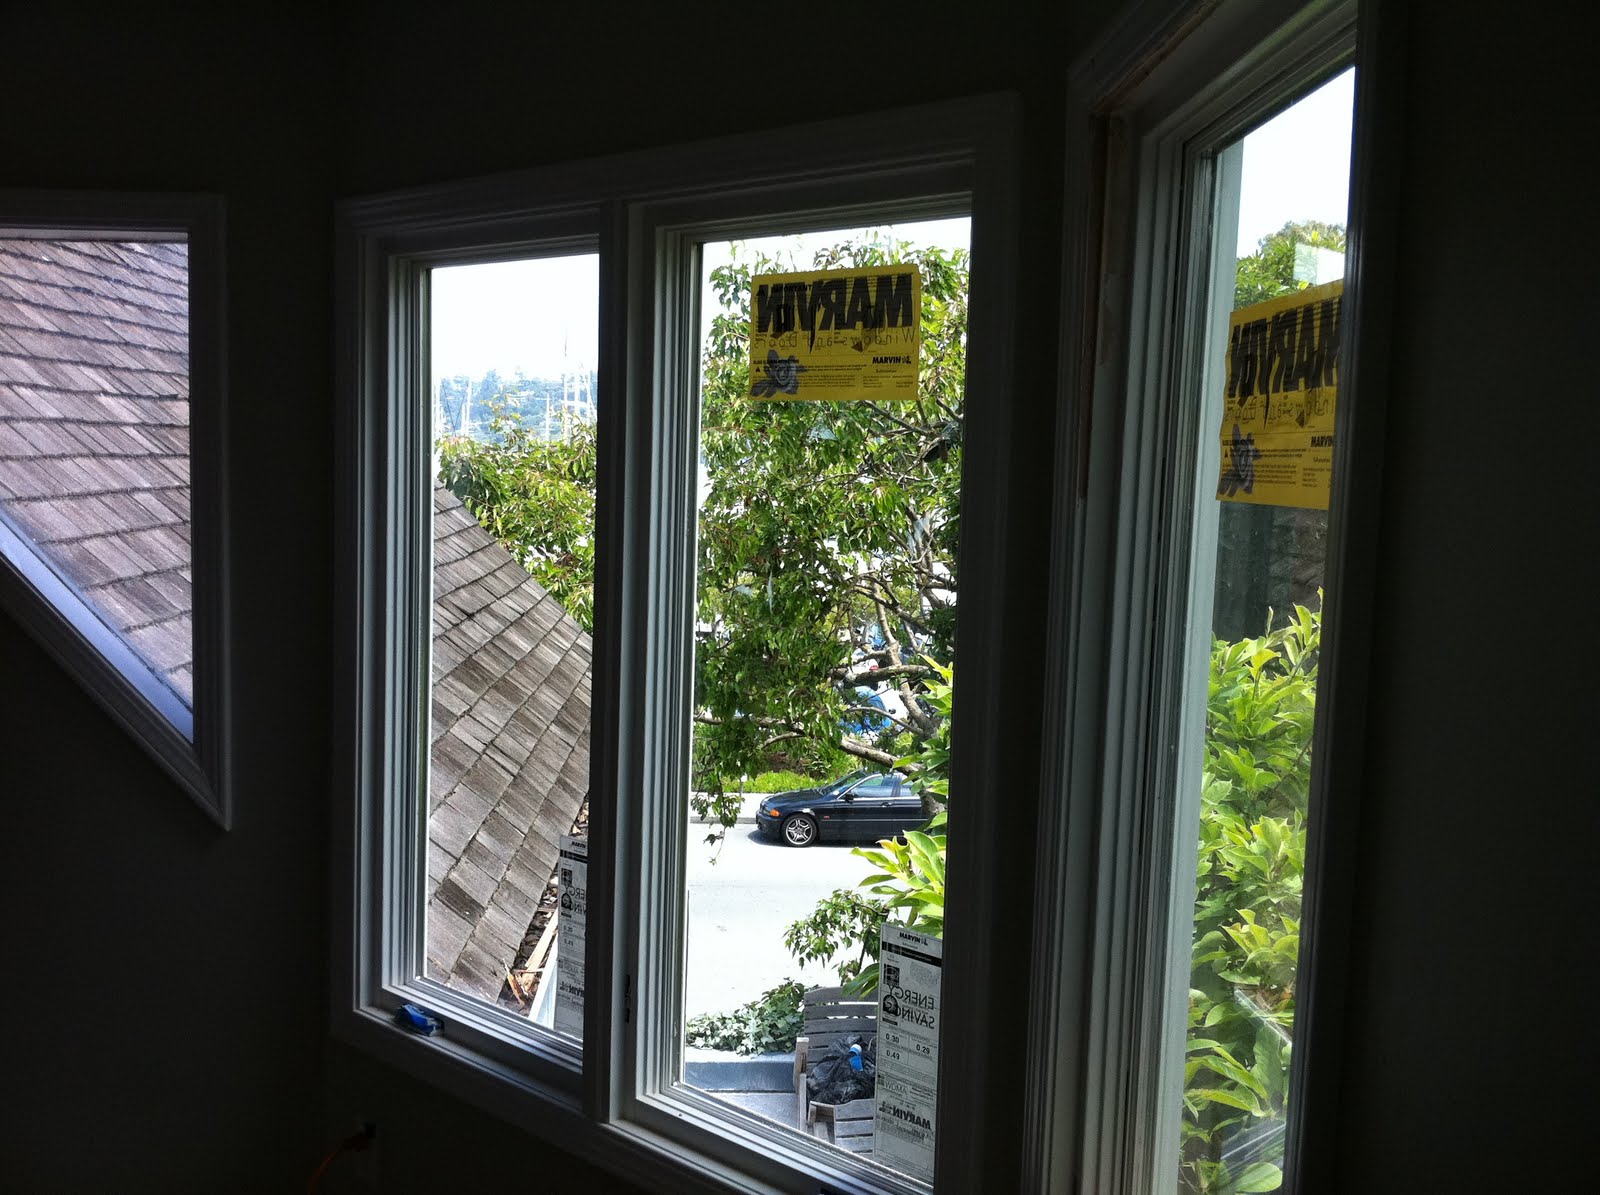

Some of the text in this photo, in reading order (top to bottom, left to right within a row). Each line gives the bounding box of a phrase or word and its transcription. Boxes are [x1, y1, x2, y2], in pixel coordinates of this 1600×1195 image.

[872, 356, 900, 364] MARVIN
[899, 932, 921, 944] MARVIN
[885, 1033, 900, 1044] 0.30
[916, 1044, 930, 1054] 0.29
[886, 1050, 900, 1060] 0.49
[884, 1081, 908, 1095] WDMA
